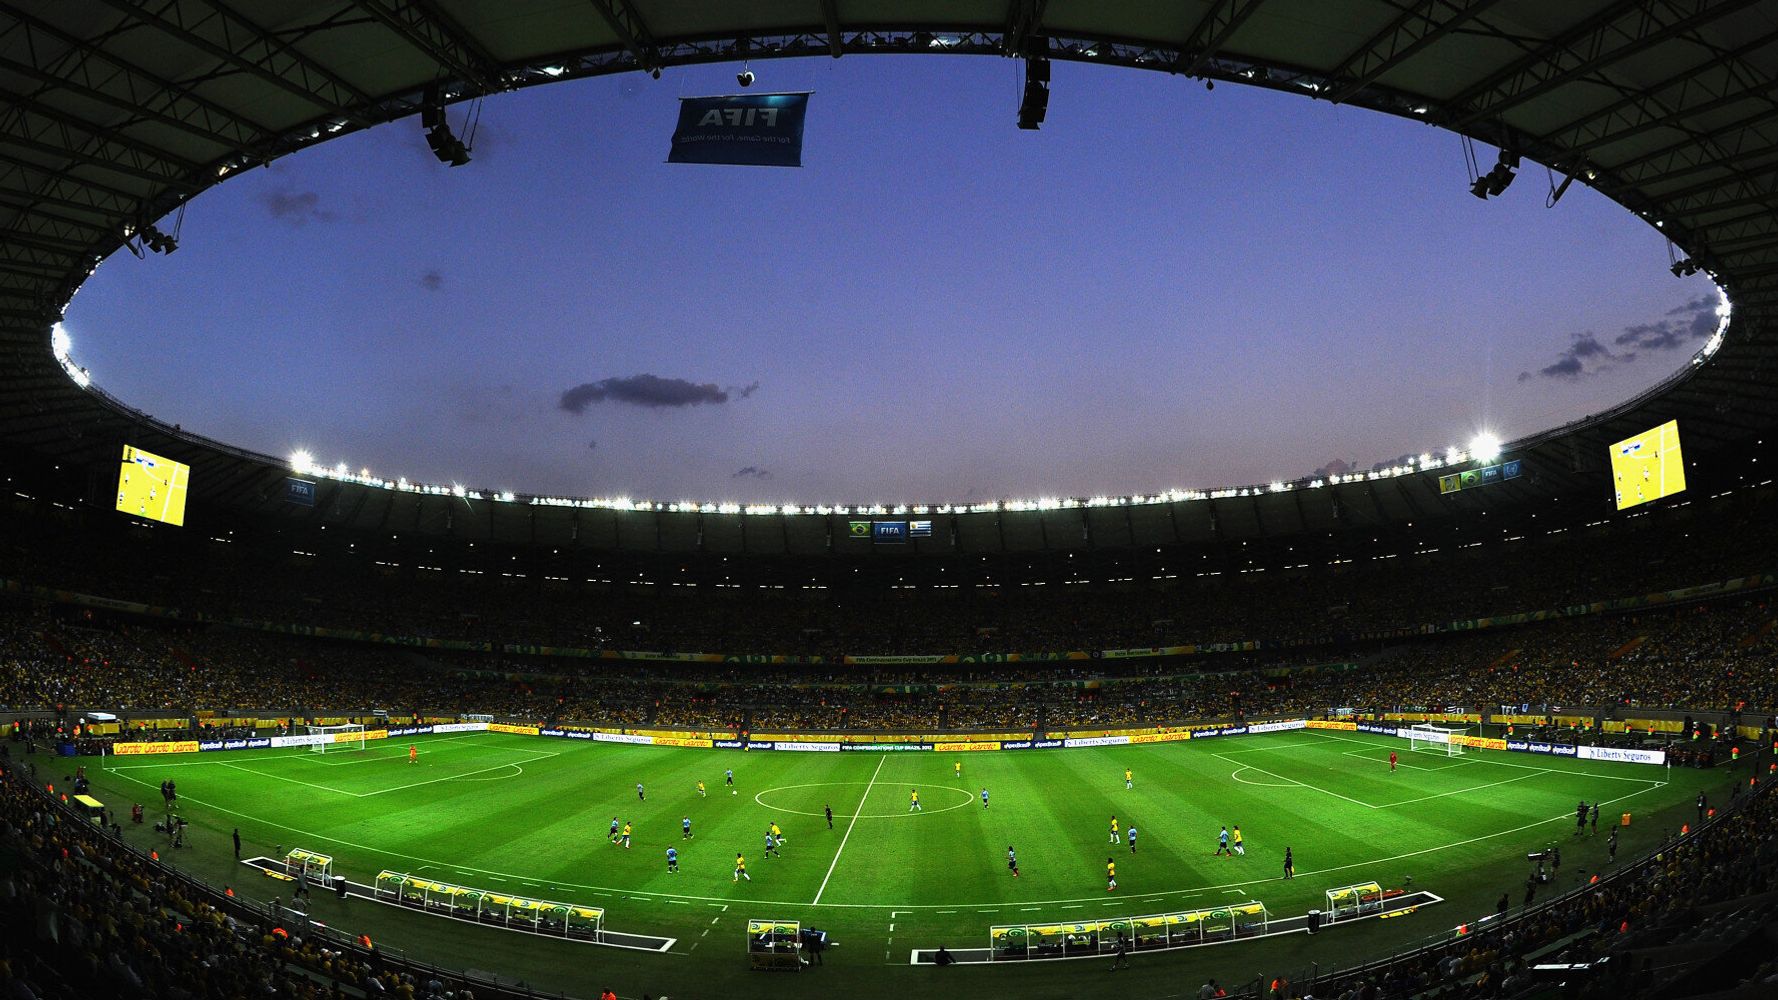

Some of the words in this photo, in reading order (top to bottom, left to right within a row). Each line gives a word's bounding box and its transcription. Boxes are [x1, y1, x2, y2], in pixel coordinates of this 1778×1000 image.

[291, 484, 309, 495] FIFA
[881, 527, 900, 535] FIFA
[655, 737, 679, 745] Garoto
[683, 739, 708, 747] Garoto
[1100, 737, 1128, 746] Seguros
[1133, 735, 1158, 743] Garoto
[1161, 733, 1186, 741] Garoto
[116, 743, 141, 754] Garoto
[144, 742, 169, 753] Garoto
[173, 742, 197, 752] Garoto
[939, 743, 965, 751] Garoto
[1596, 748, 1621, 759] Liberty
[1623, 750, 1651, 761] Seguros
